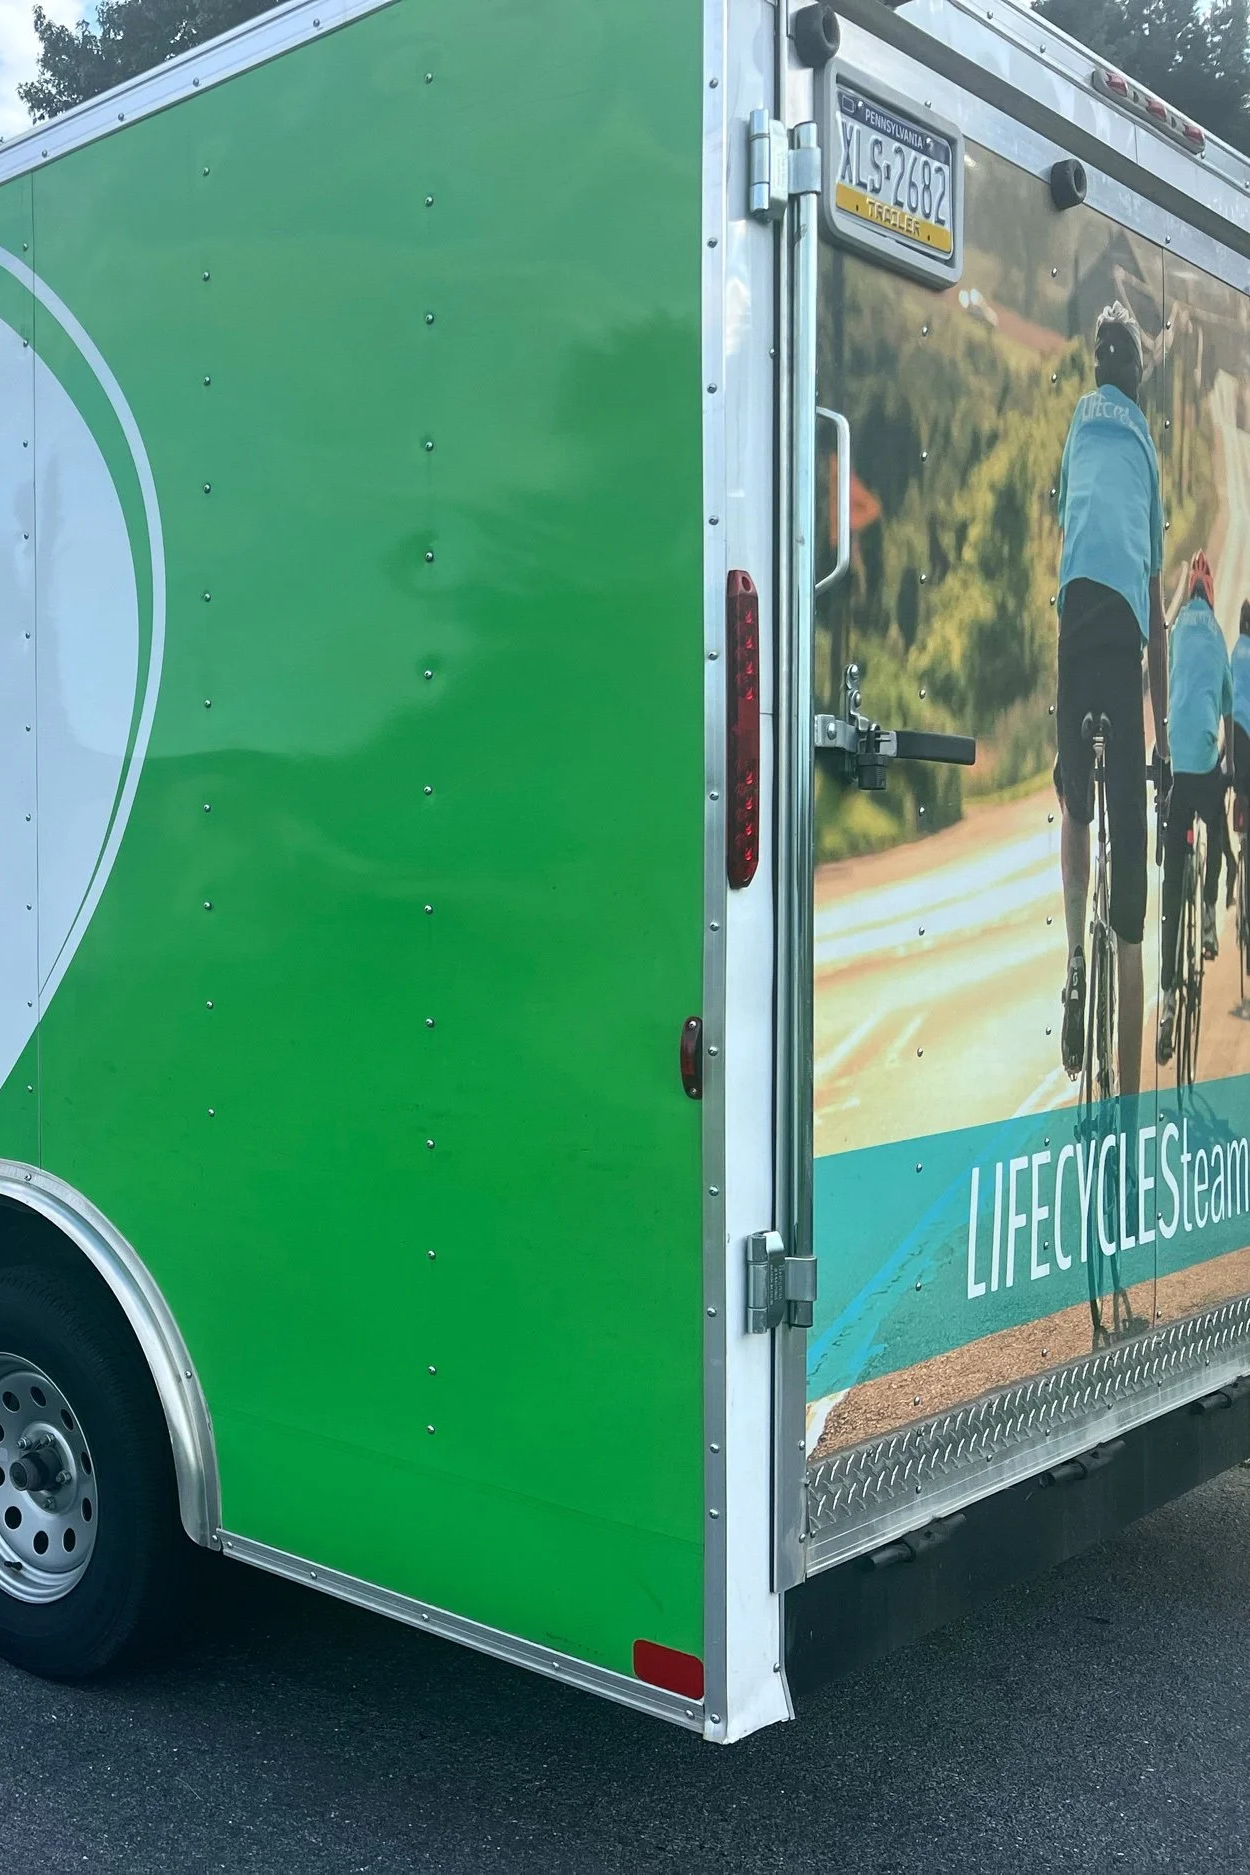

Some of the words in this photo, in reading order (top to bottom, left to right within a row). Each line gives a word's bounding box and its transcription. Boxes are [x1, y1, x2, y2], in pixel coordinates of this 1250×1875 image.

[865, 108, 924, 149] PENNSYLVANIA
[866, 198, 921, 236] TRAILER
[967, 1116, 1249, 1300] LIFECYCLESteam
